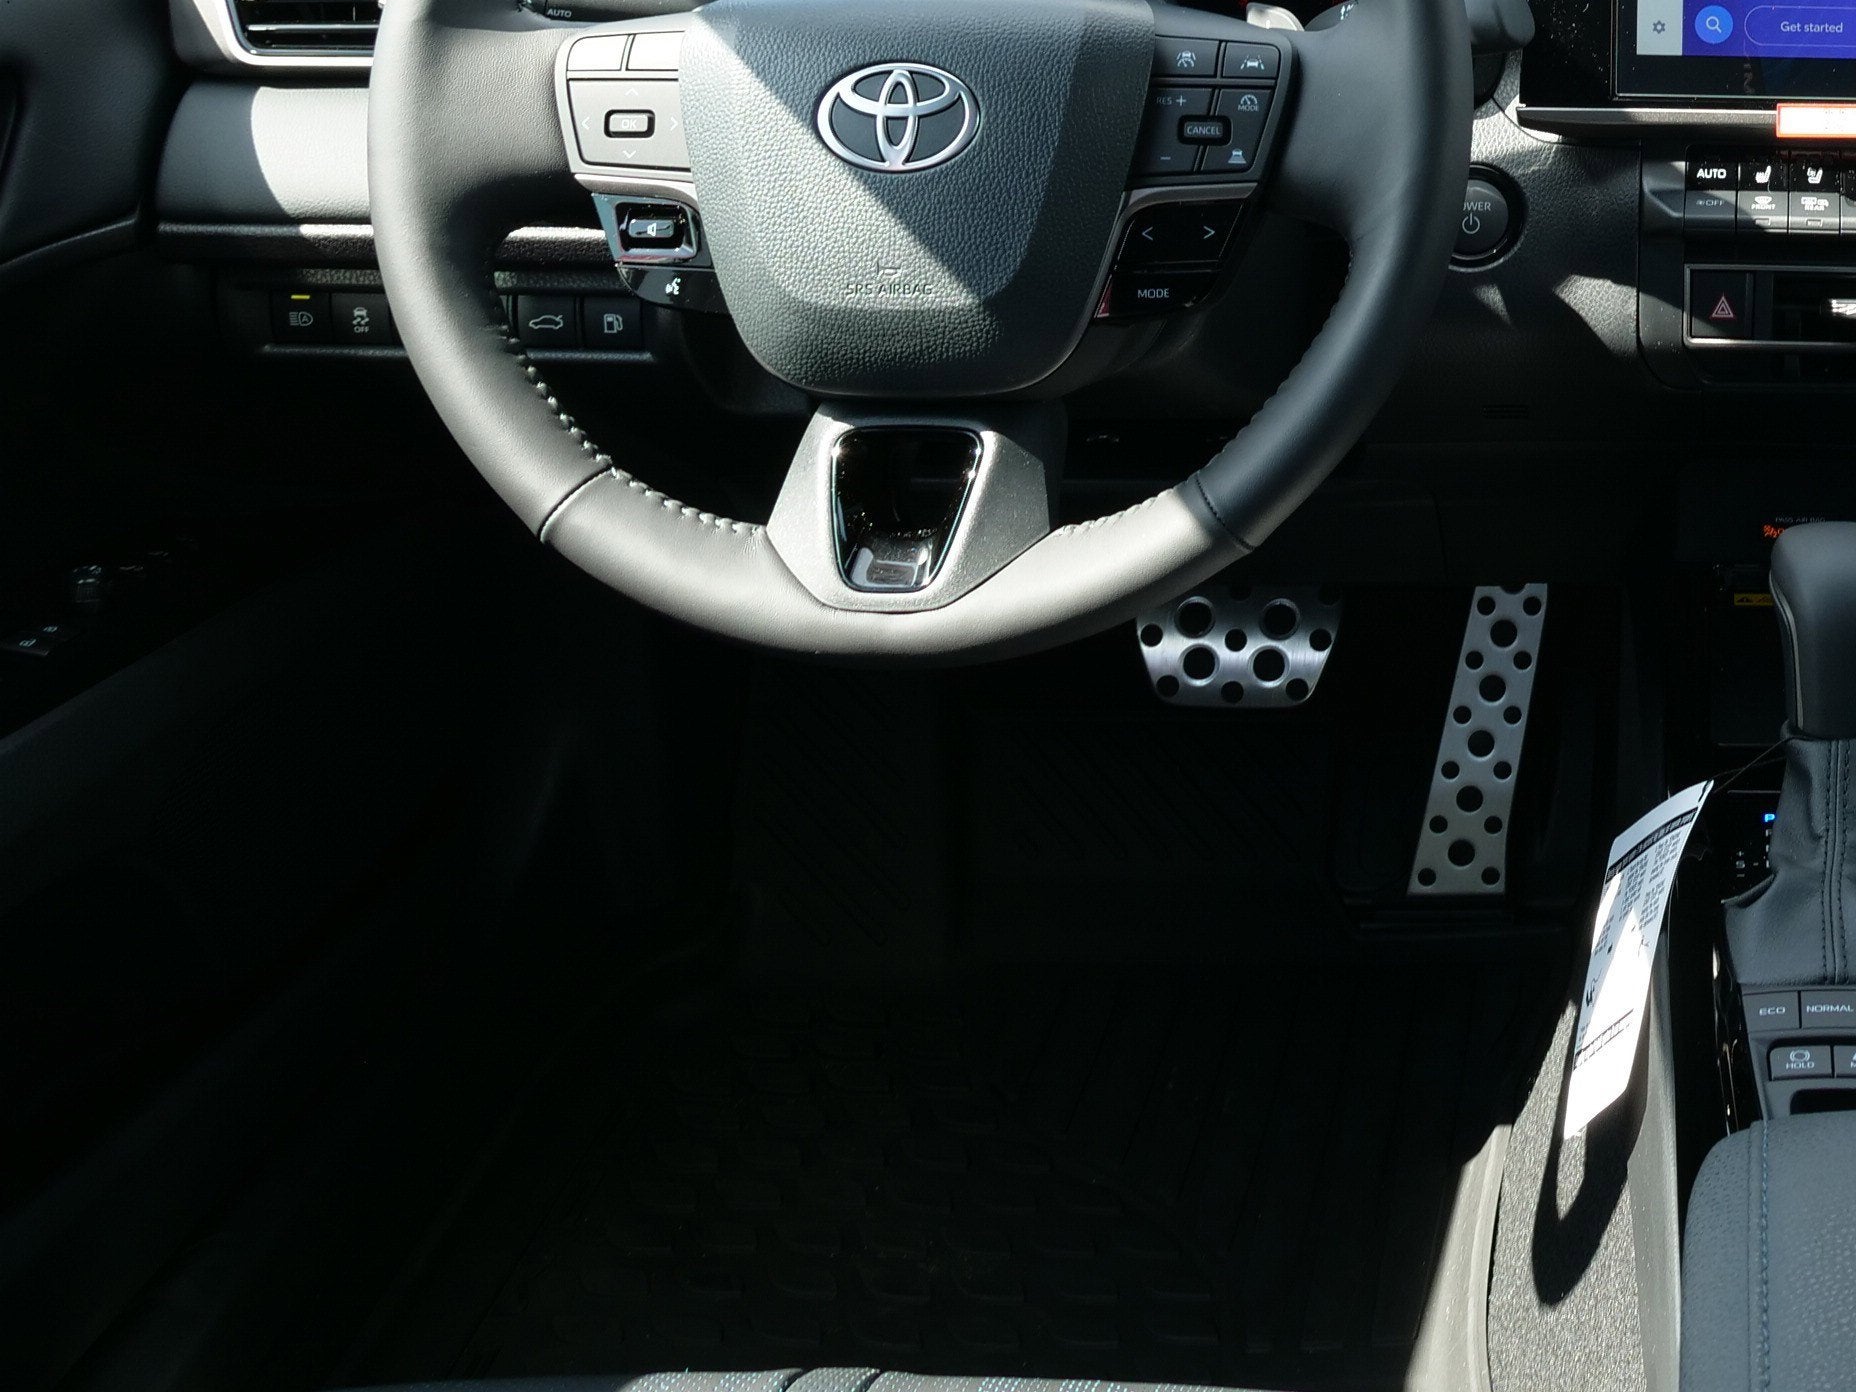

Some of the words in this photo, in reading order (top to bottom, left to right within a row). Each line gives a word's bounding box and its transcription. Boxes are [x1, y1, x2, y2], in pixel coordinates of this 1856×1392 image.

[547, 9, 572, 20] AUTO
[1780, 20, 1802, 34] Get
[1803, 22, 1844, 34] started
[1156, 96, 1174, 106] RES
[1237, 103, 1261, 112] MODE
[621, 119, 638, 131] OK
[1186, 125, 1222, 137] CANCEL
[1696, 168, 1727, 179] AUTO
[1462, 201, 1492, 212] WER
[1751, 203, 1776, 211] FRONT
[845, 283, 872, 296] SRS
[877, 283, 933, 297] AIRBAG
[1137, 288, 1170, 300] MODE
[354, 325, 370, 335] OFF
[1764, 813, 1776, 823] P
[1759, 1006, 1786, 1016] ECO
[1806, 1004, 1854, 1014] NORMAL
[1785, 1061, 1815, 1070] HOLD
